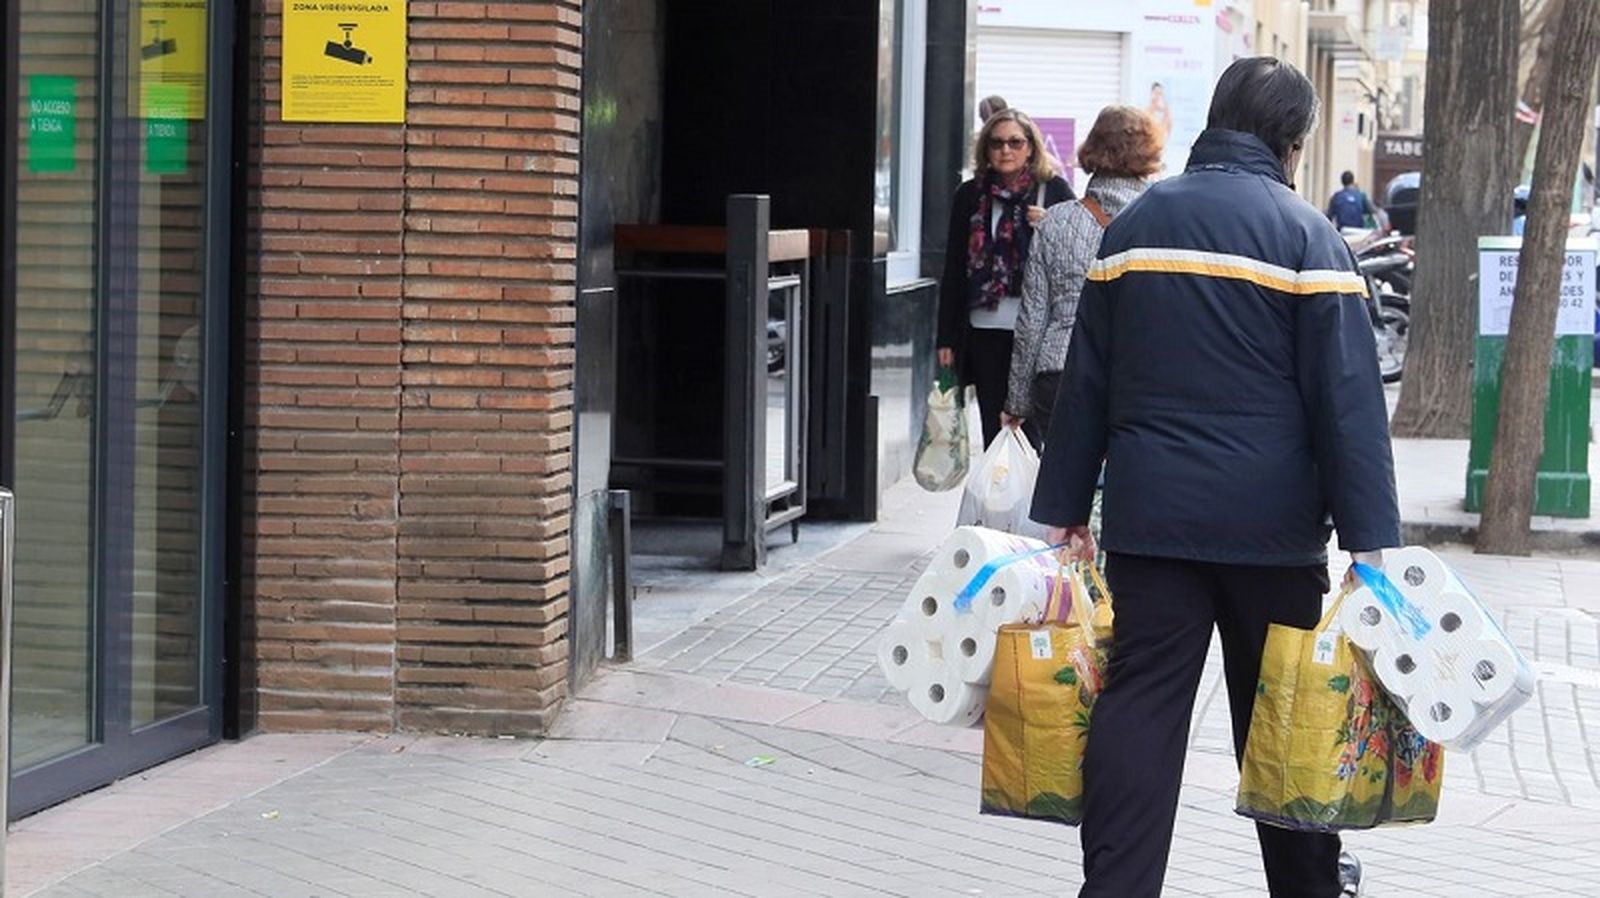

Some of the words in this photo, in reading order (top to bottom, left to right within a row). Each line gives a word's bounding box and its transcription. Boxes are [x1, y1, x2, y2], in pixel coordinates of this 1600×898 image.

[293, 3, 318, 11] ZONA
[320, 3, 389, 12] VIDEOVIGILADA
[32, 99, 42, 113] NO
[43, 100, 71, 115] ACCESO
[38, 118, 63, 133] TIENDA
